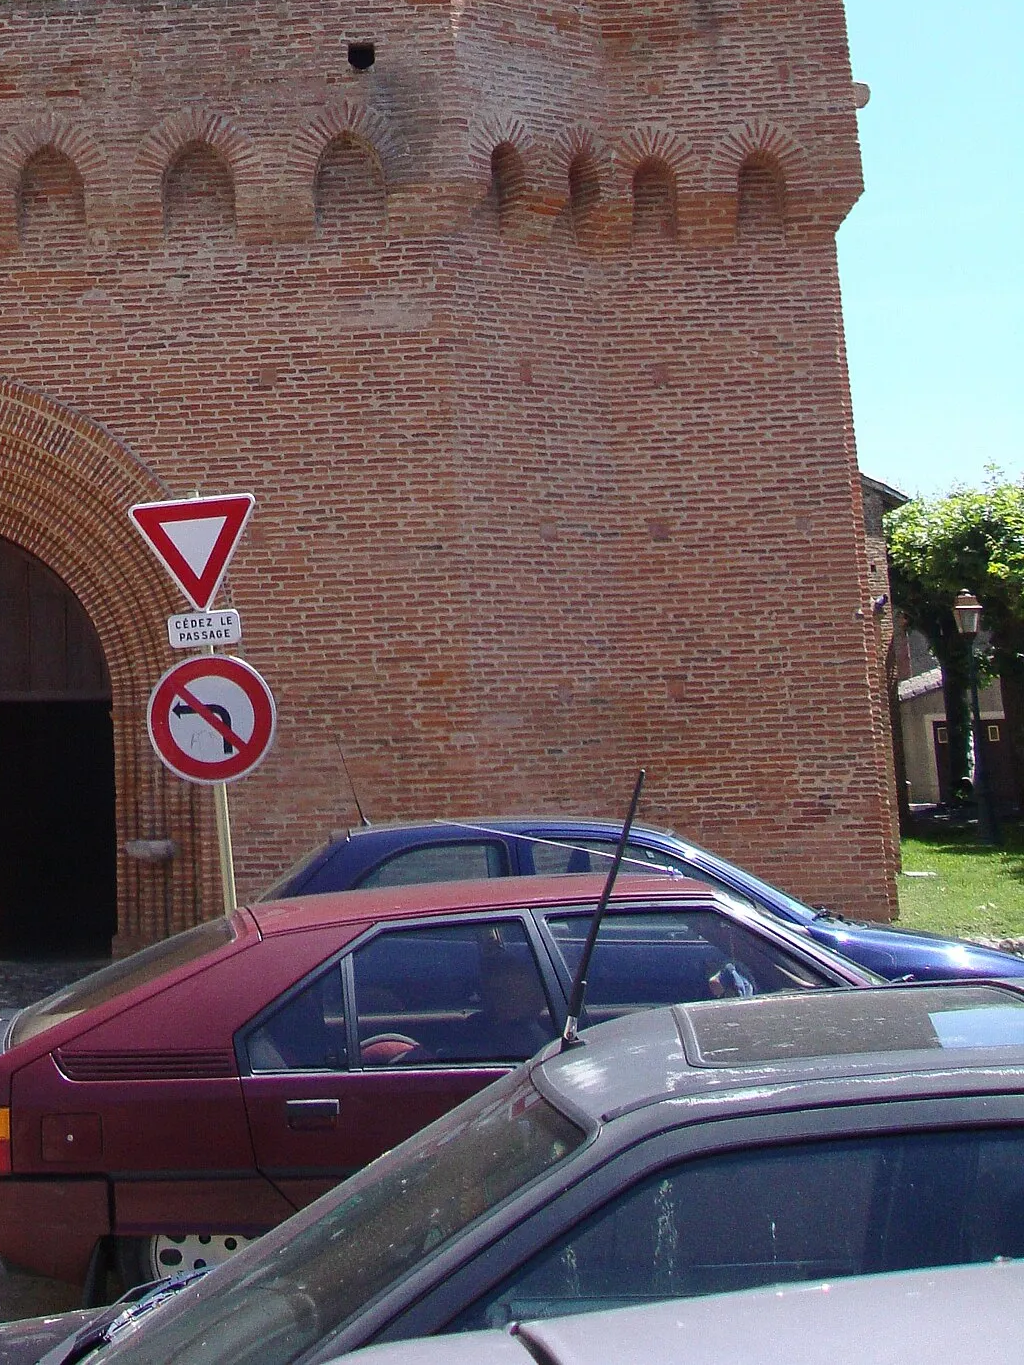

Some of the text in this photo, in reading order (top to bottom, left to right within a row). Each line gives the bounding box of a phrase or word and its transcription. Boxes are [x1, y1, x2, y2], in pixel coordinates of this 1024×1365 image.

[175, 616, 233, 630] CÉDEZ LE
[179, 629, 231, 642] PASSAGE
